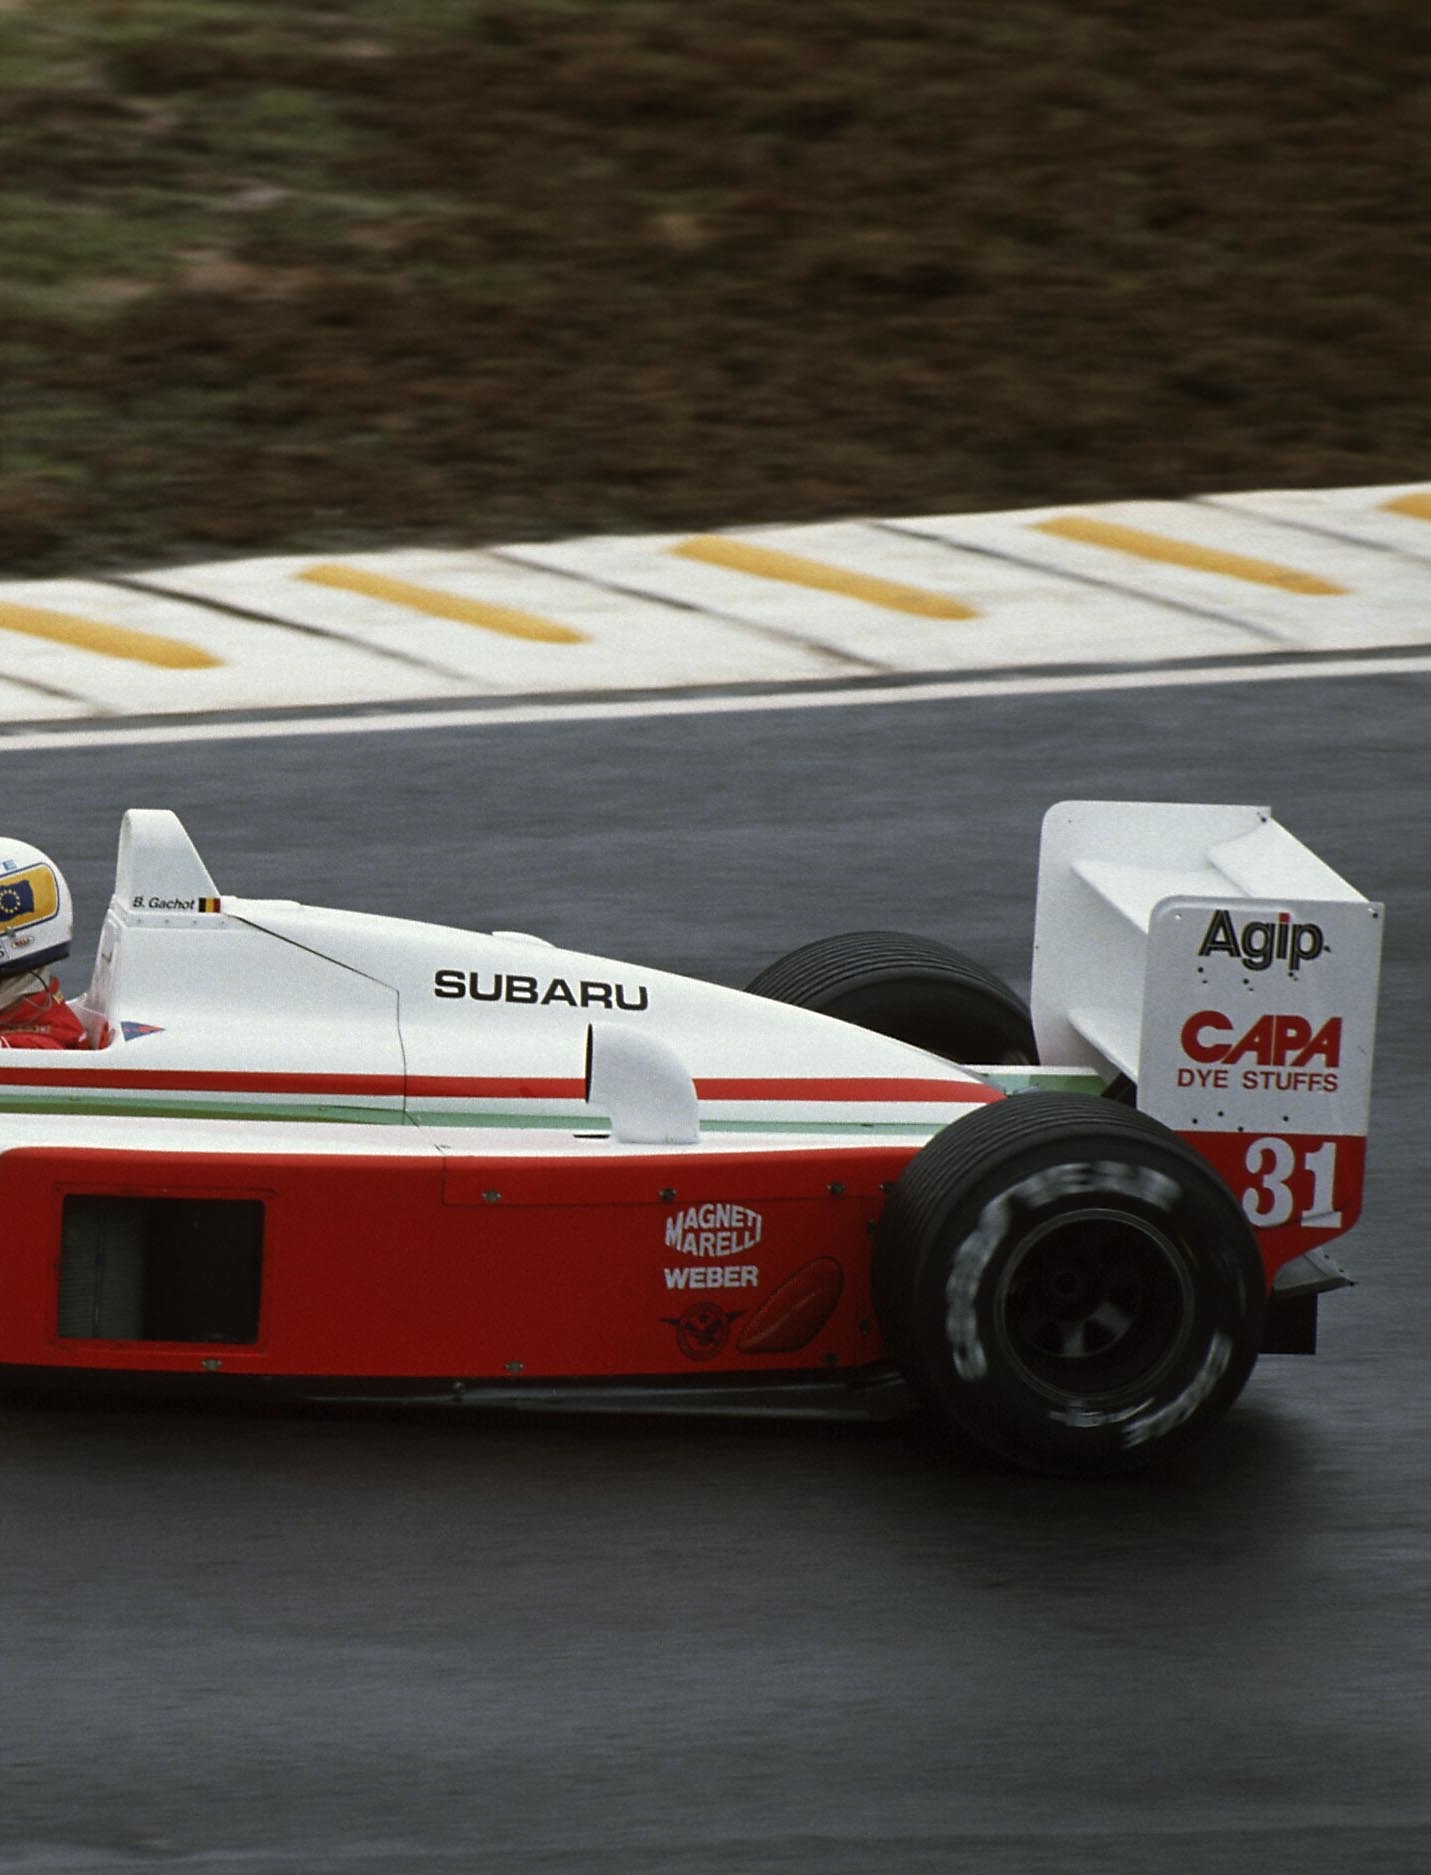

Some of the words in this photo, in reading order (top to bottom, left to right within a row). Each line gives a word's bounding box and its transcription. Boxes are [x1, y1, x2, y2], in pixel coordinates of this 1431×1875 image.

[133, 896, 145, 908] B.
[149, 897, 195, 910] Gachot
[1198, 910, 1324, 971] Agip
[434, 969, 648, 1012] SUBARU
[1181, 1010, 1343, 1068] CAPA
[1177, 1068, 1229, 1088] DYE
[1242, 1070, 1338, 1092] STUFFS
[1242, 1136, 1342, 1229] 31
[664, 1265, 759, 1289] WEBER
